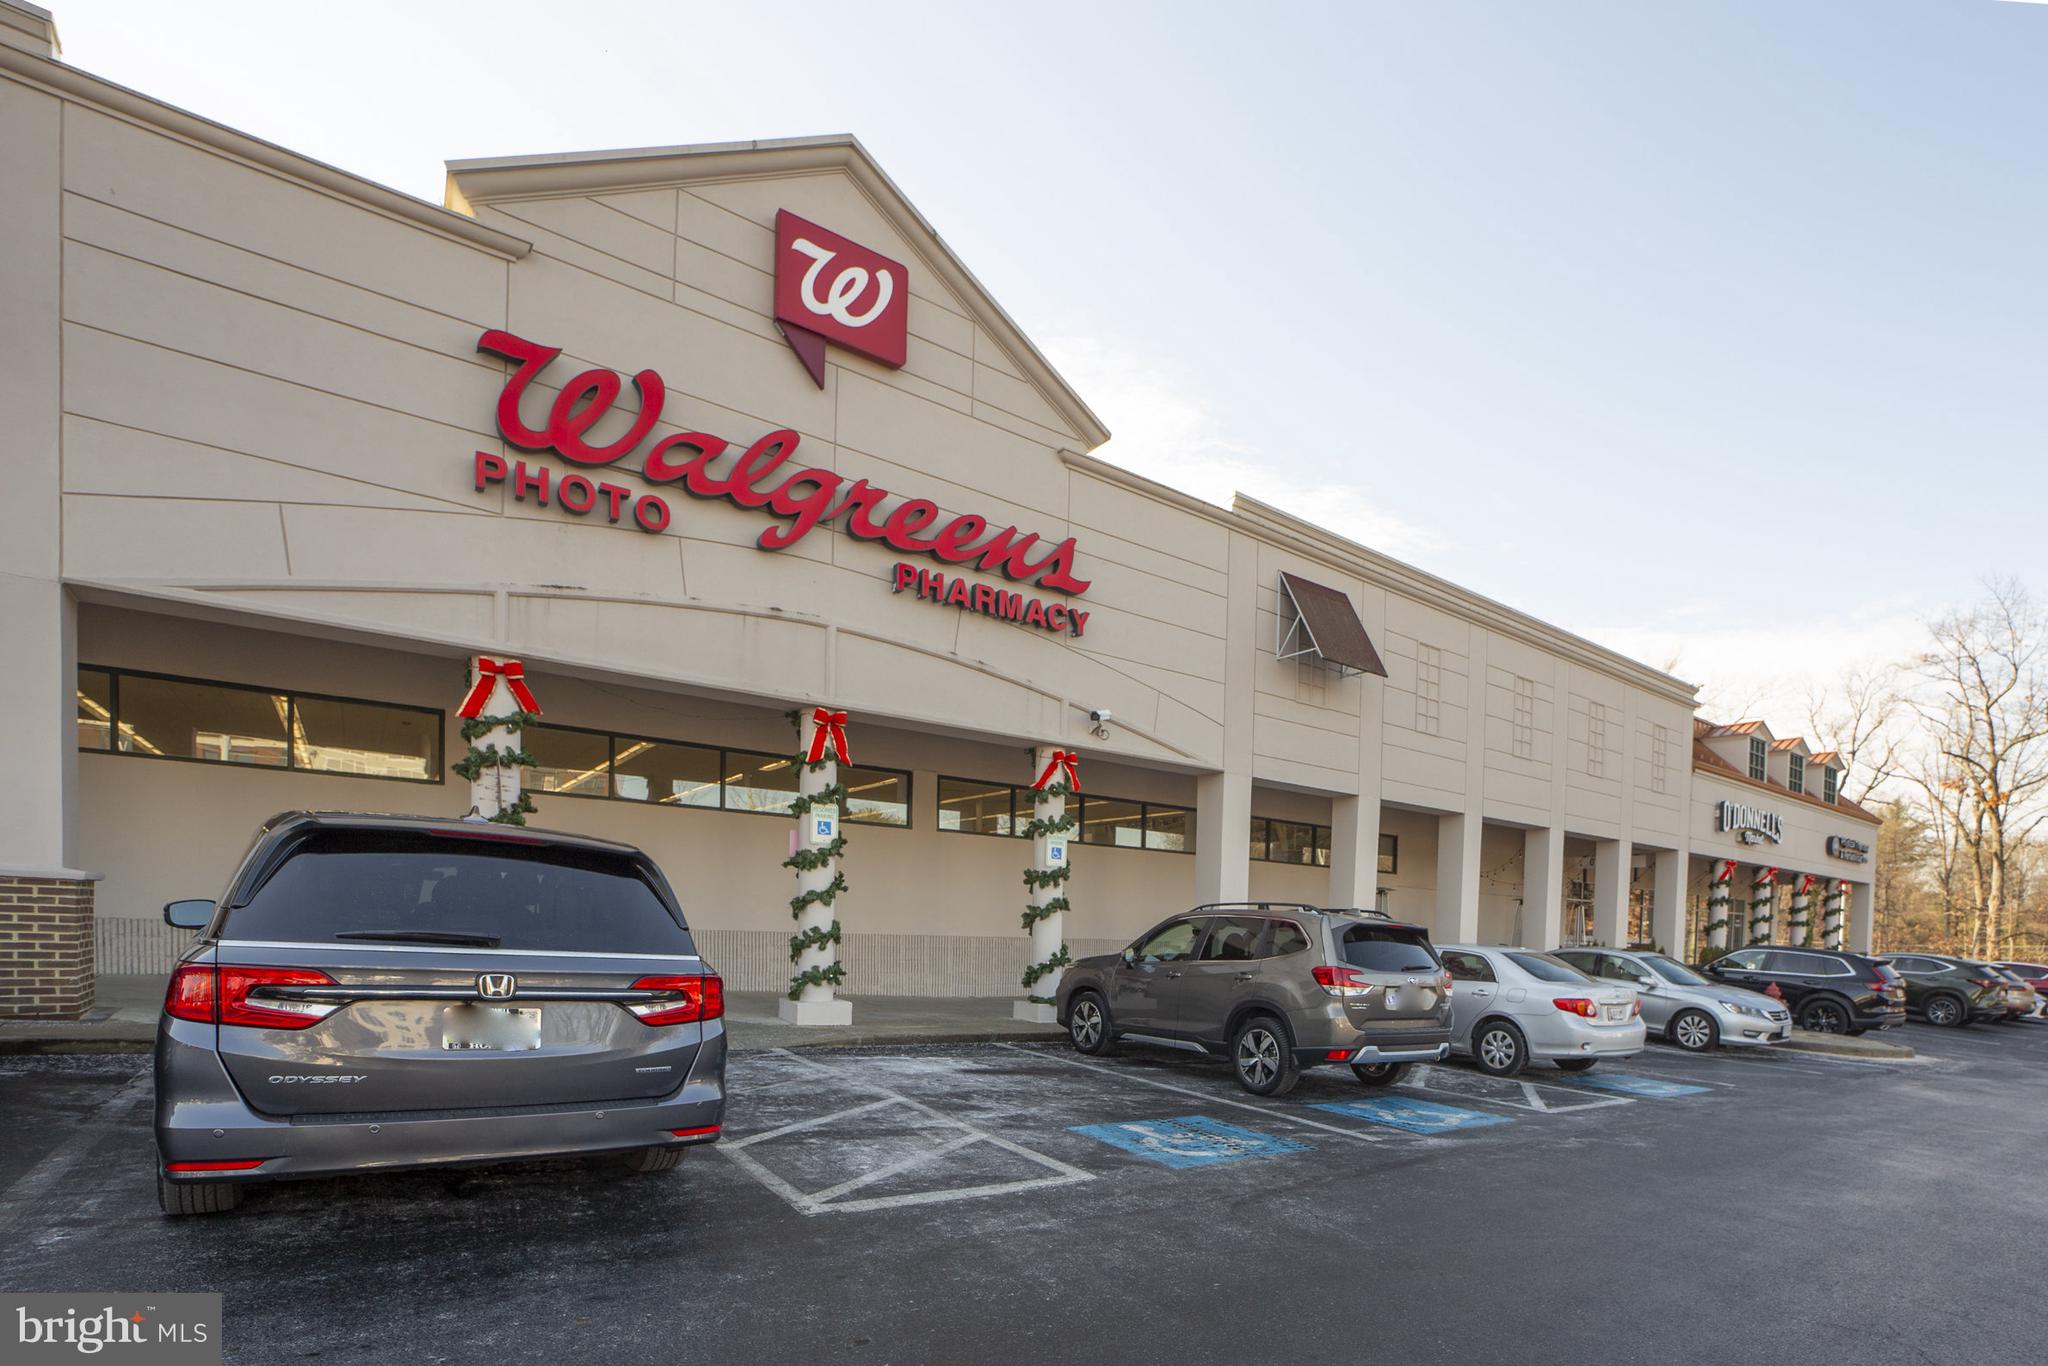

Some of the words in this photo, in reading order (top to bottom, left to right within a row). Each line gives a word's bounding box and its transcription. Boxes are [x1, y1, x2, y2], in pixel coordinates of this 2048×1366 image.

[475, 450, 671, 534] PHOTO
[476, 328, 1091, 596] Walgreens
[893, 561, 1091, 638] PHARMACY
[268, 1075, 368, 1084] ODYSSEY
